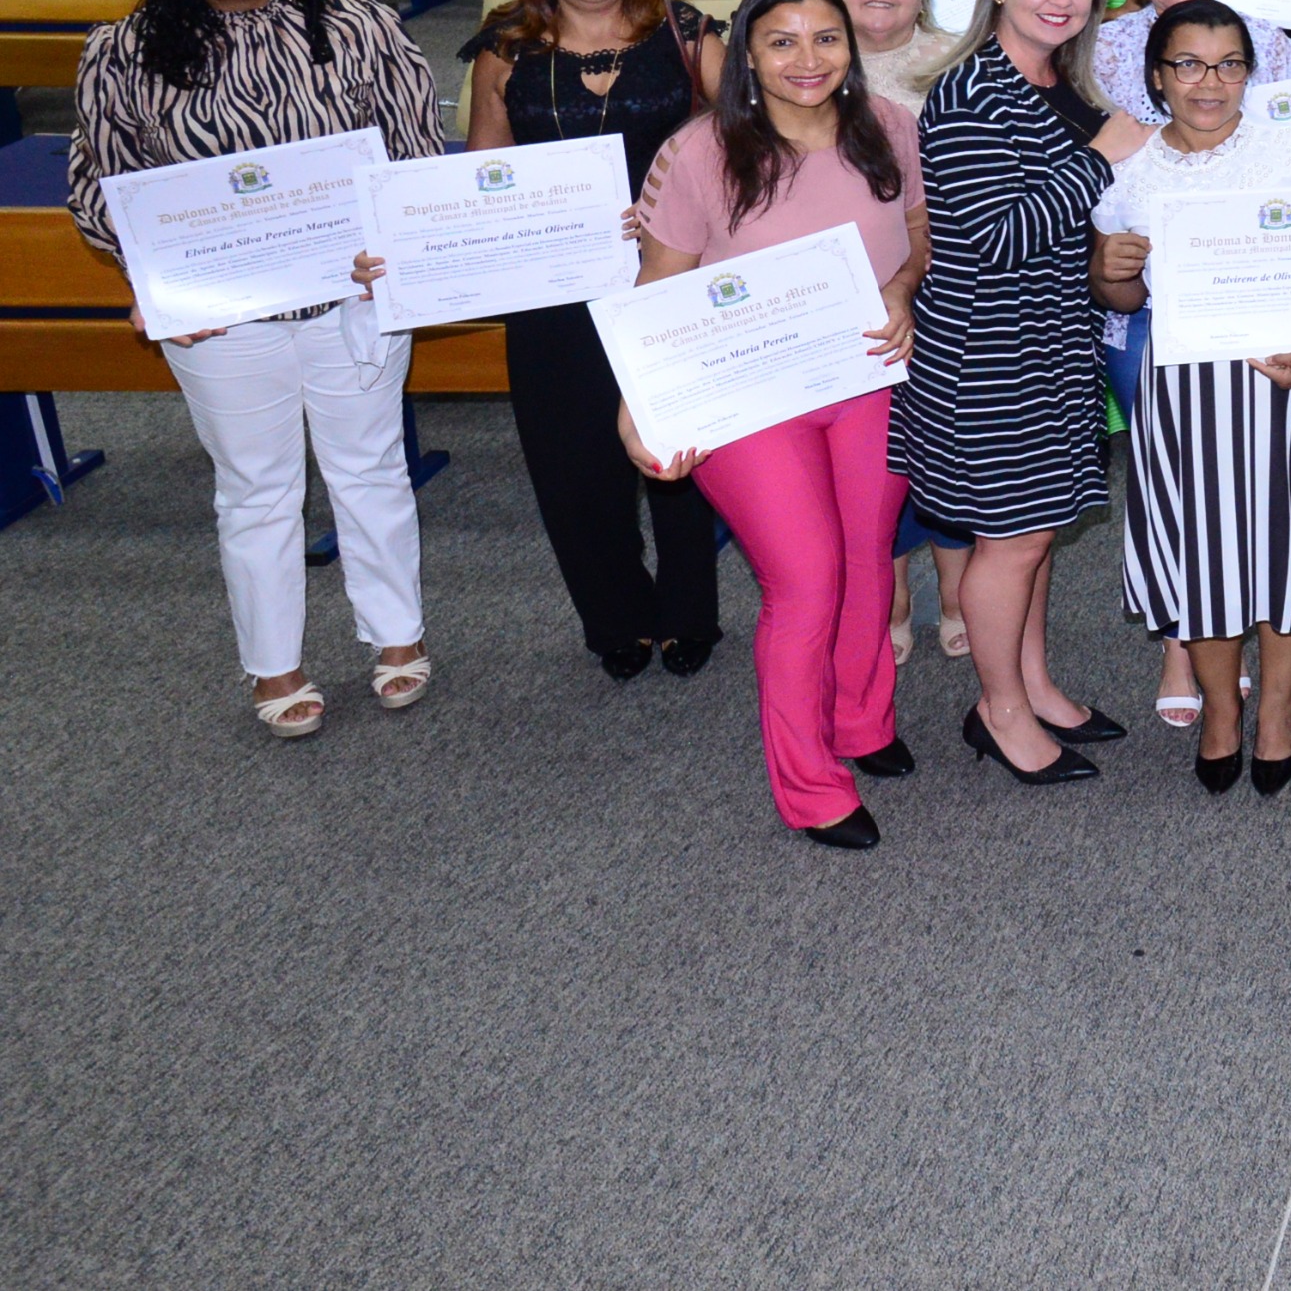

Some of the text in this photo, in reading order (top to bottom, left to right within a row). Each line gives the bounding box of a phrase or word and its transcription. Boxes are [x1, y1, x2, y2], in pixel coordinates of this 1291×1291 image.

[185, 246, 217, 259] Elvira
[236, 237, 262, 247] Silva
[265, 228, 303, 241] Pereira
[306, 218, 351, 231] Marques
[422, 240, 459, 252] Ângela
[461, 236, 500, 247] Simone
[517, 229, 542, 238] Silva
[544, 223, 584, 234] Oliveira
[1212, 276, 1258, 285] Dalvirene
[701, 333, 799, 368] Nora Maria Pereira
